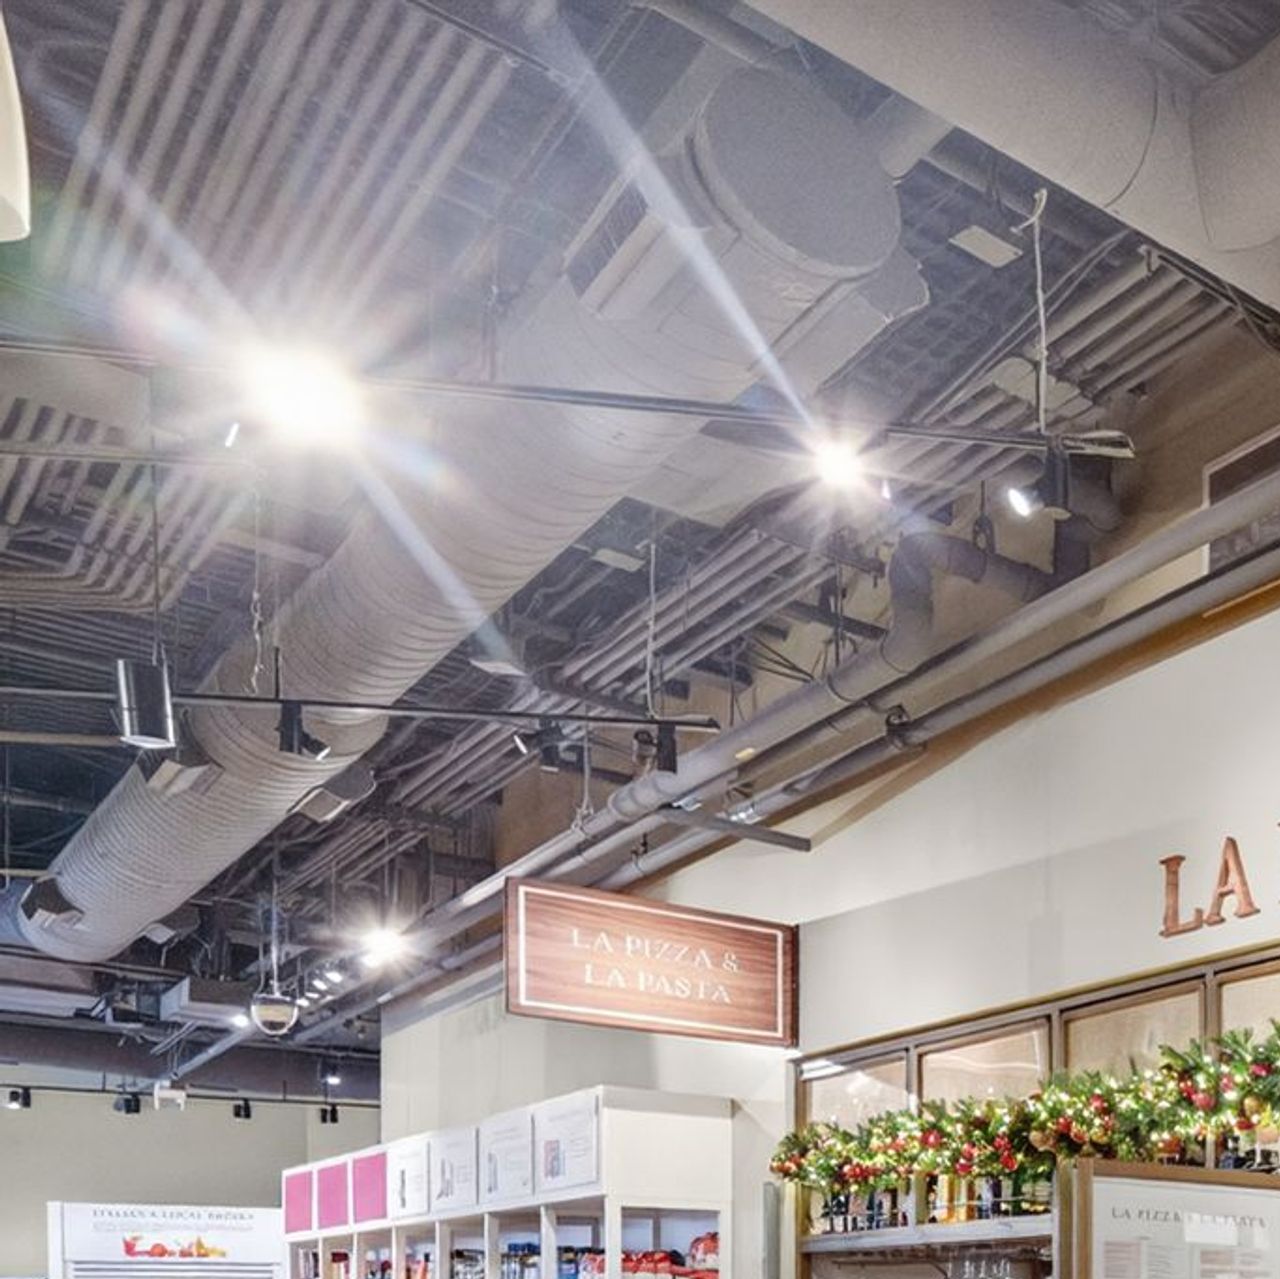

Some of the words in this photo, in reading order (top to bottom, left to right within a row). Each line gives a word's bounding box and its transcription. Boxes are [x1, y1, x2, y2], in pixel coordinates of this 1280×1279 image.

[1159, 836, 1261, 938] LA
[571, 927, 614, 954] LA
[625, 933, 713, 969] PIZZA
[722, 952, 740, 973] &
[584, 963, 627, 989] LA
[637, 969, 732, 1004] PASTA
[1111, 1206, 1132, 1220] LA
